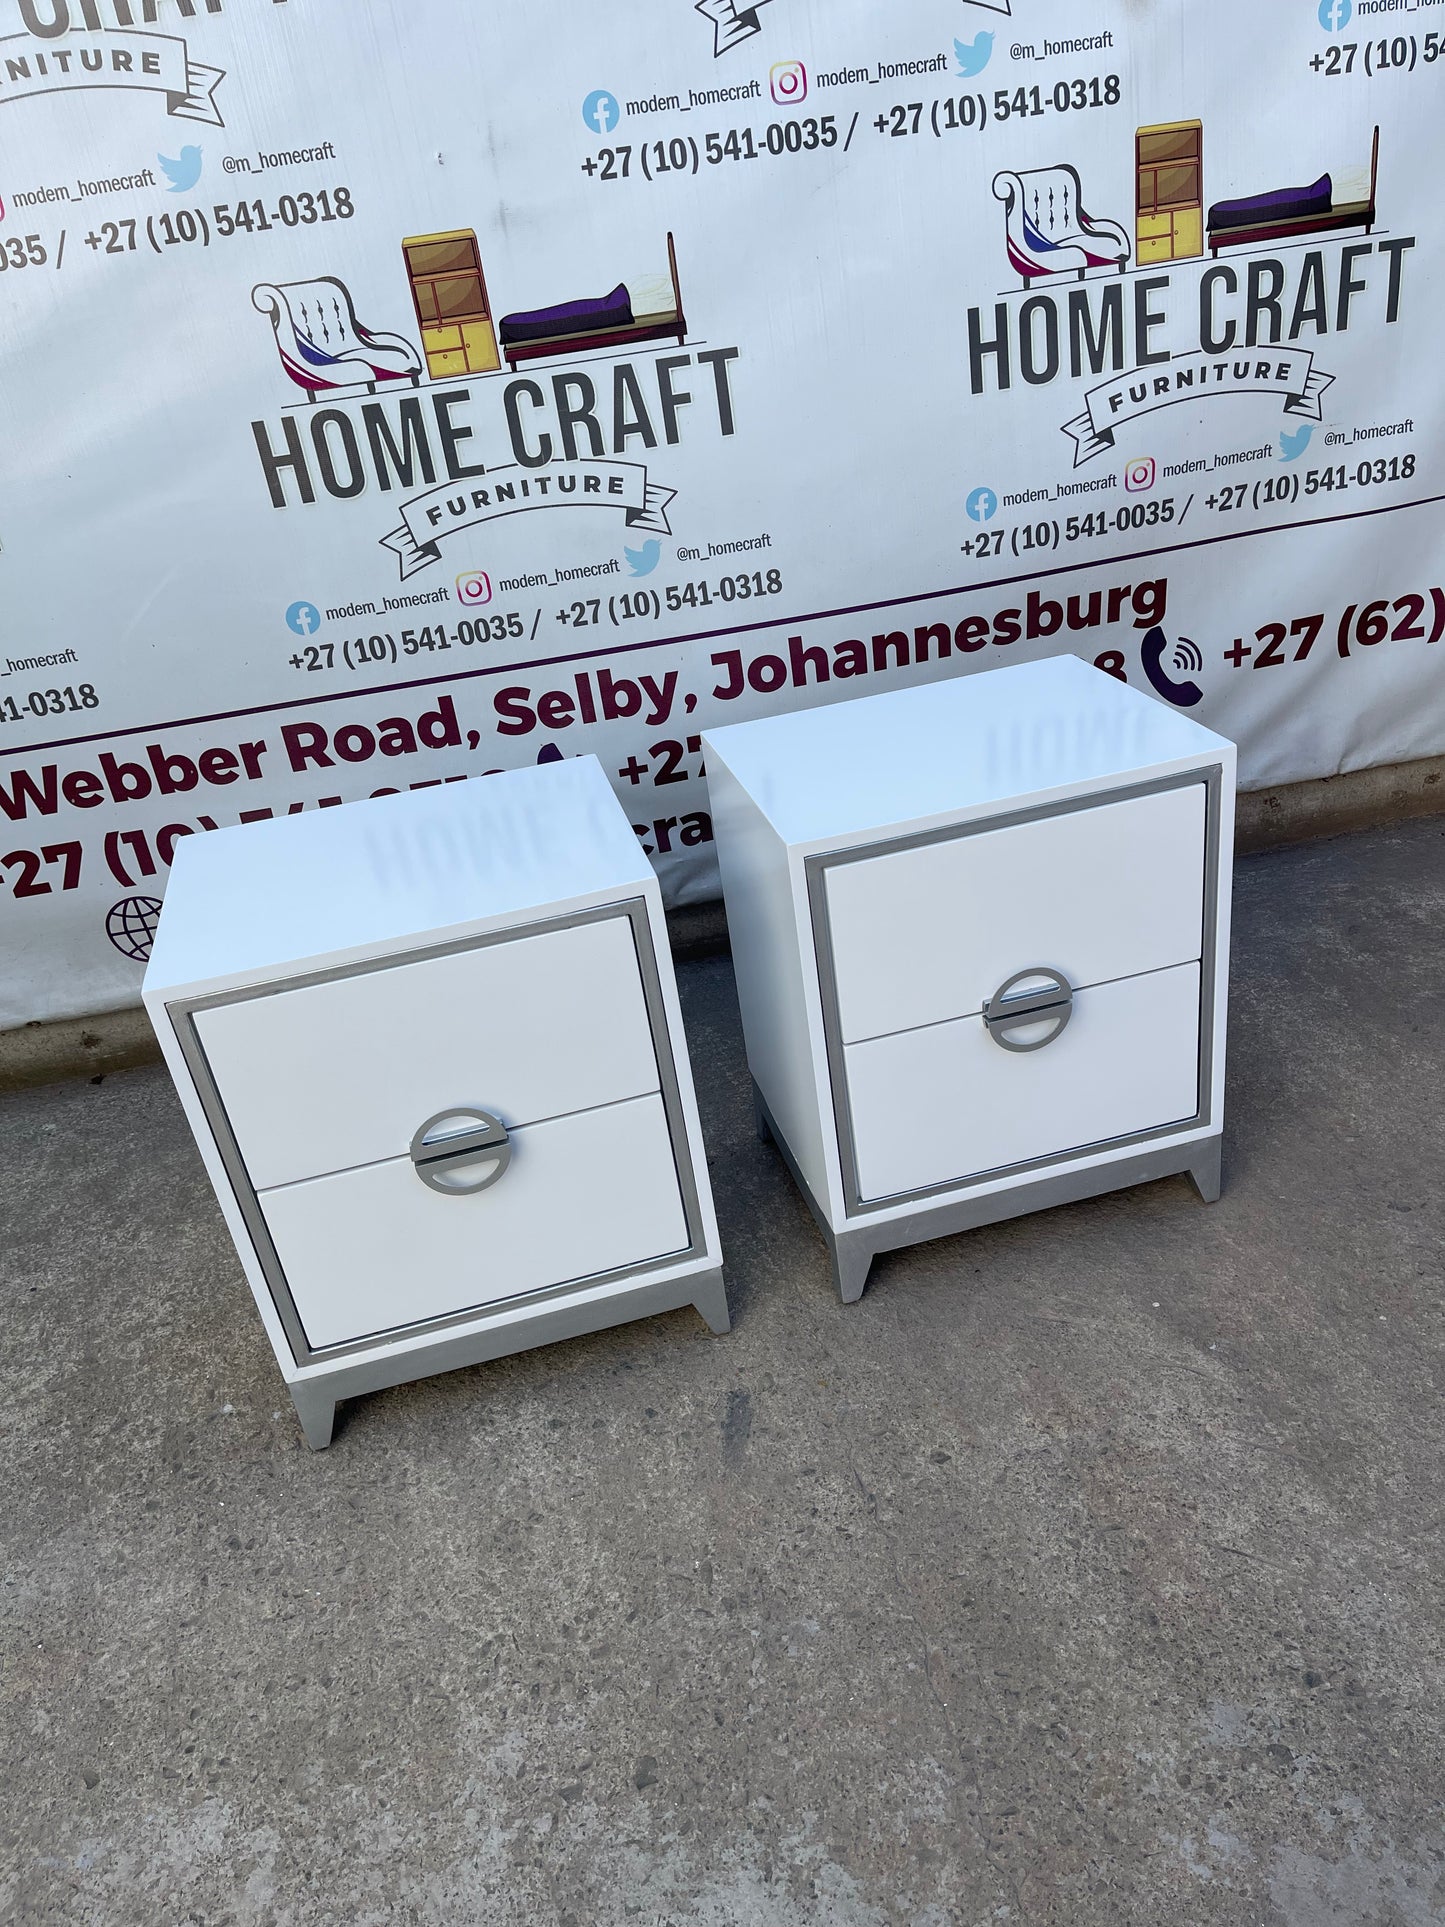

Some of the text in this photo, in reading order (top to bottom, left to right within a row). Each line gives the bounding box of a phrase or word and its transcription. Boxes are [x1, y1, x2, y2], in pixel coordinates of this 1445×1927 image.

[626, 31, 1113, 115] modern_homecraft modern_homecraft @m_homecraft
[1309, 43, 1357, 76] +27
[1364, 36, 1417, 77] (10)
[222, 142, 336, 174] @m_homecraft
[581, 145, 632, 180] +27
[641, 137, 699, 181] (10)
[705, 115, 838, 165] 541-0035
[873, 103, 923, 137] +27
[931, 94, 987, 137] (10)
[994, 74, 1121, 121] 541-0318
[84, 219, 137, 254] +27
[147, 209, 210, 254] (10)
[213, 187, 355, 236] 541-0318
[967, 236, 1416, 395] HOME CRAFT
[250, 346, 739, 509] HOME CRAFT
[1109, 361, 1292, 413] FURNITURE
[425, 475, 624, 526] FURNITURE
[1003, 419, 1414, 507] modern_homecraft modern_homecraft @m_homecraft
[960, 530, 1005, 559] +27
[1011, 521, 1060, 557] (10)
[1065, 498, 1175, 541] 541-0035
[1205, 484, 1248, 511] +27
[1252, 474, 1299, 510] (10)
[1304, 454, 1416, 495] 541-0318
[325, 533, 772, 620] modern_homecraft modern_homecraft @m_homecraft
[288, 643, 335, 671] +27
[343, 634, 397, 670] (10)
[401, 612, 524, 655] 541-0035
[556, 599, 601, 627] +27
[608, 589, 660, 626] (10)
[666, 568, 783, 611] 541-0318
[1224, 587, 1445, 670] +27 (62)
[0, 740, 267, 820] Webber
[281, 696, 481, 772] Road,
[493, 670, 698, 736] Selby,
[711, 578, 1168, 700] Johannesburg
[0, 840, 83, 898] 27
